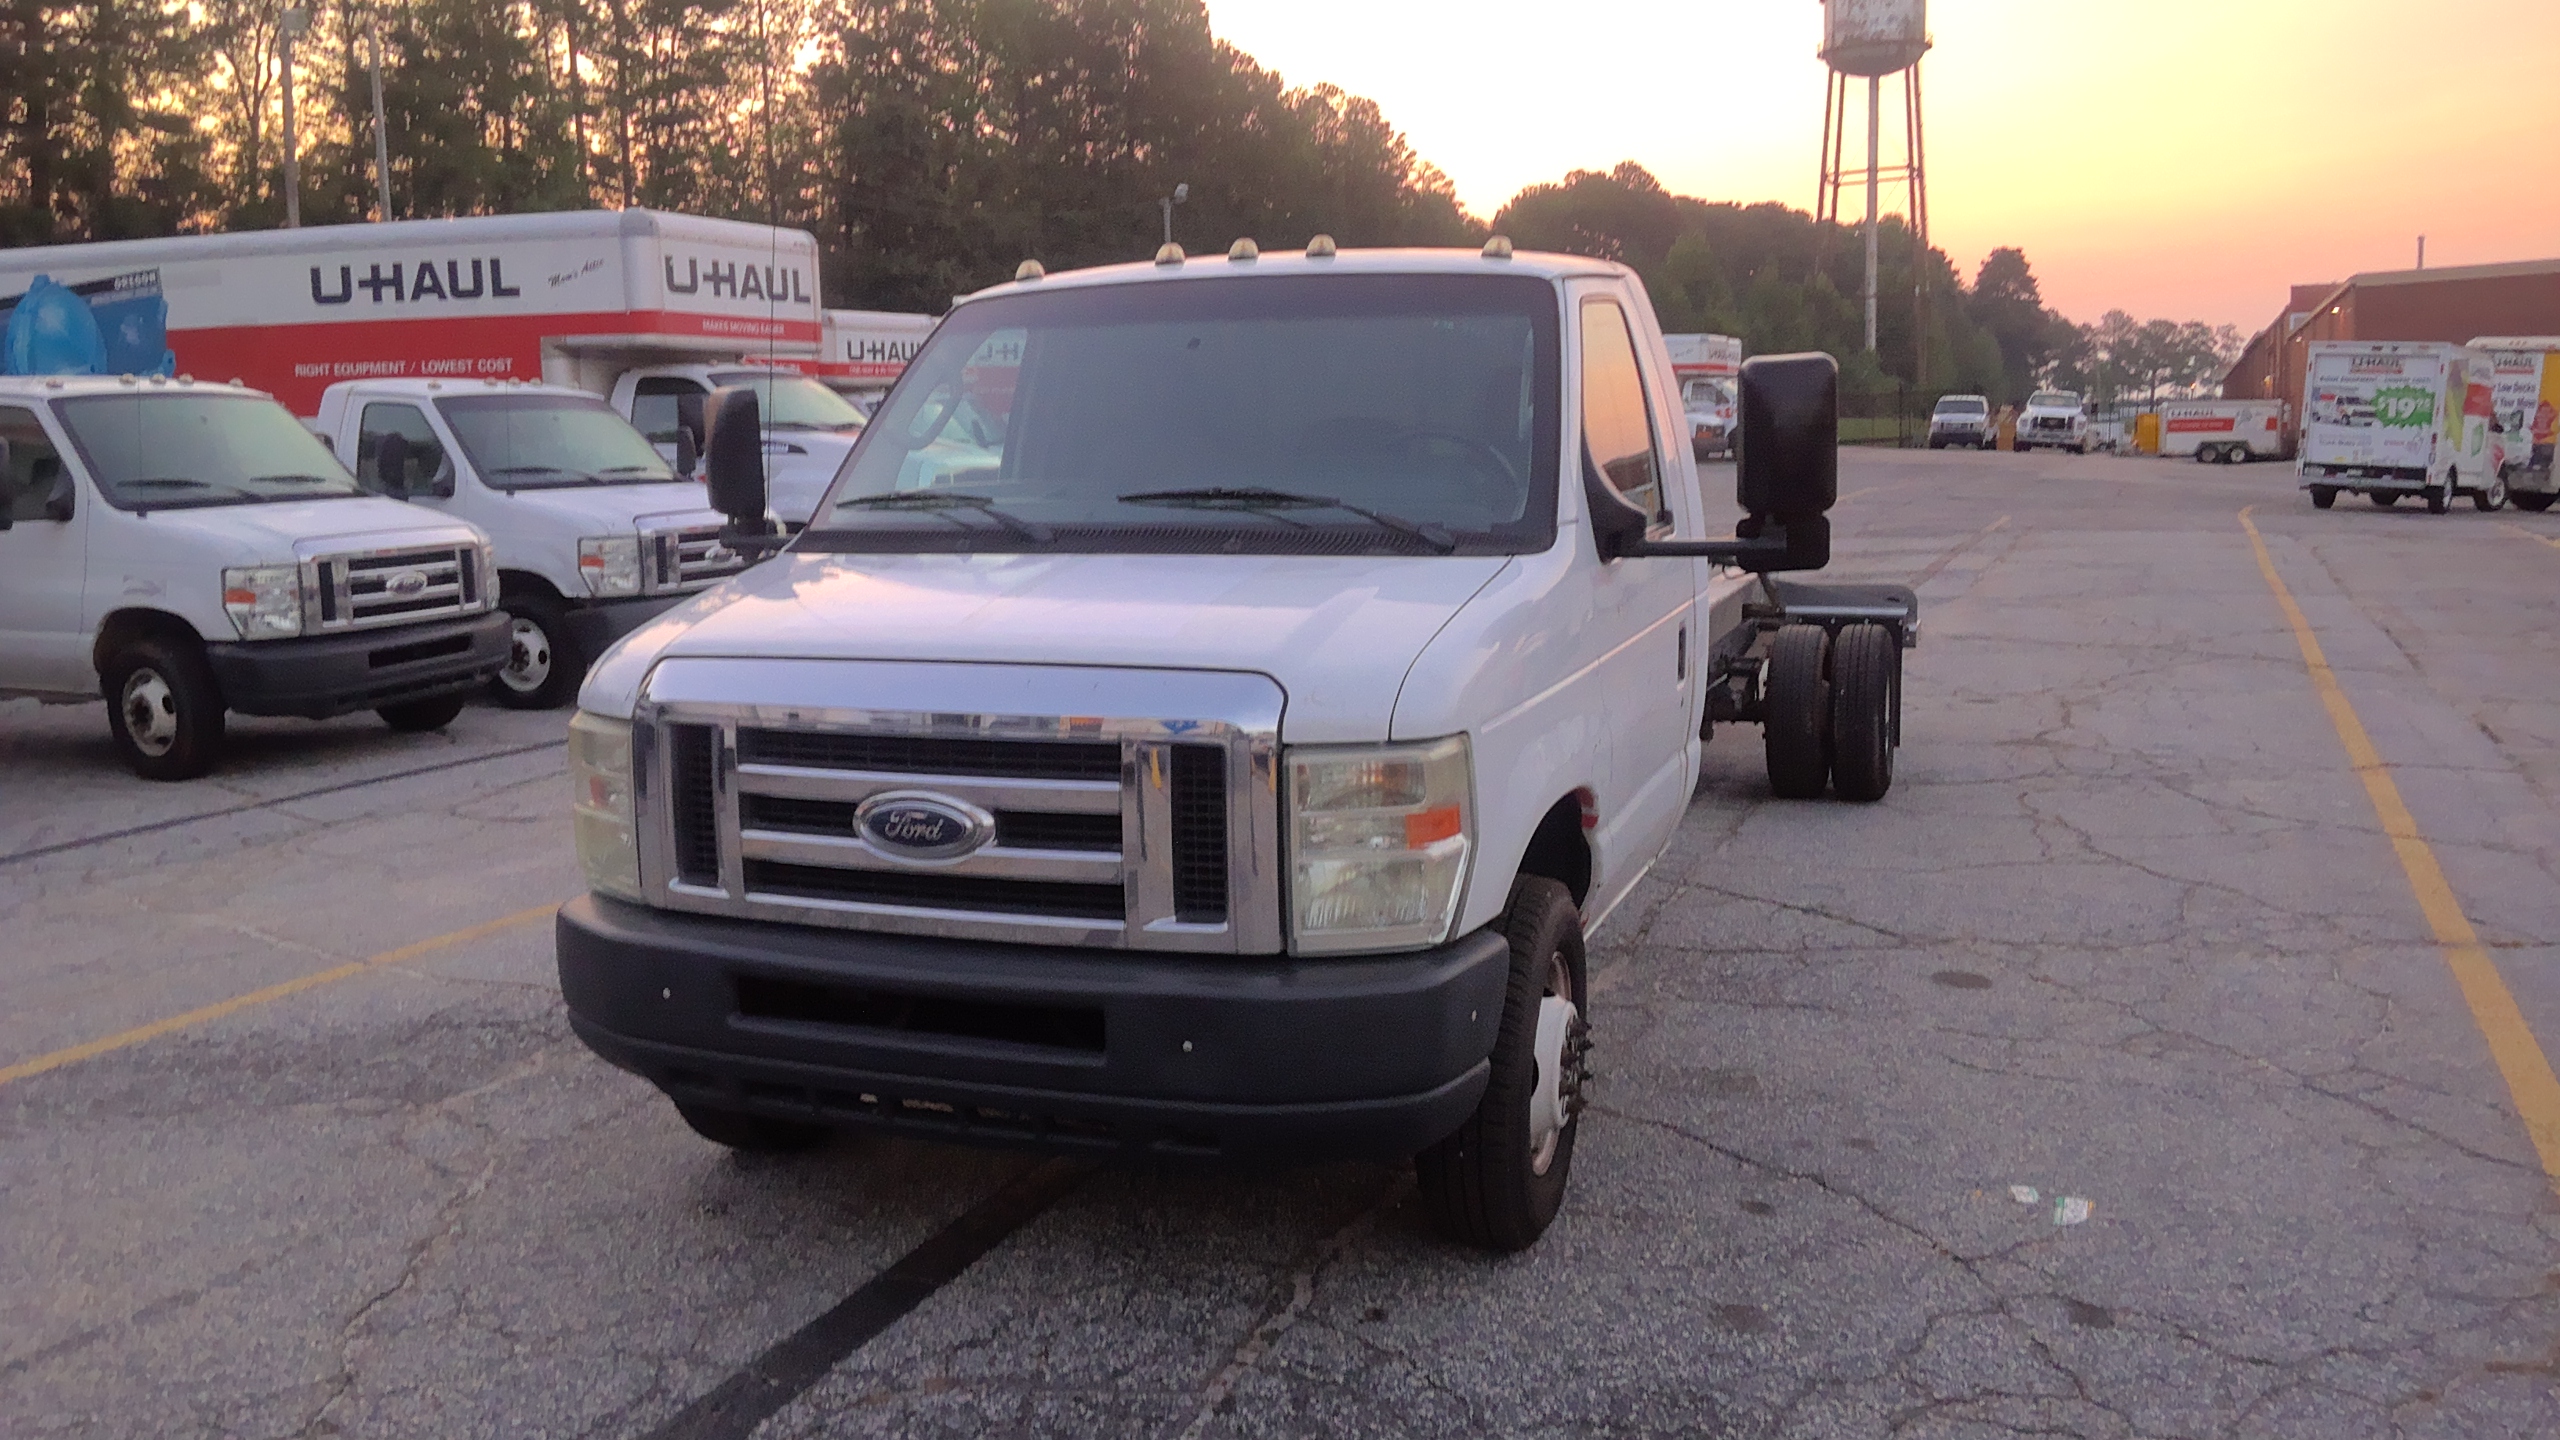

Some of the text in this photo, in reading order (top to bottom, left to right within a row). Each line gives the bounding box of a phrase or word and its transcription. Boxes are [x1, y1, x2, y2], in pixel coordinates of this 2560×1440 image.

[310, 258, 520, 304] U-HAUL
[665, 254, 811, 304] U-HAUL
[847, 340, 922, 361] U-HAU
[295, 362, 330, 377] RIGHT
[333, 360, 406, 376] EQUIPMENT
[420, 358, 474, 375] LOWEST
[477, 357, 514, 373] COST
[884, 811, 943, 841] Ford
